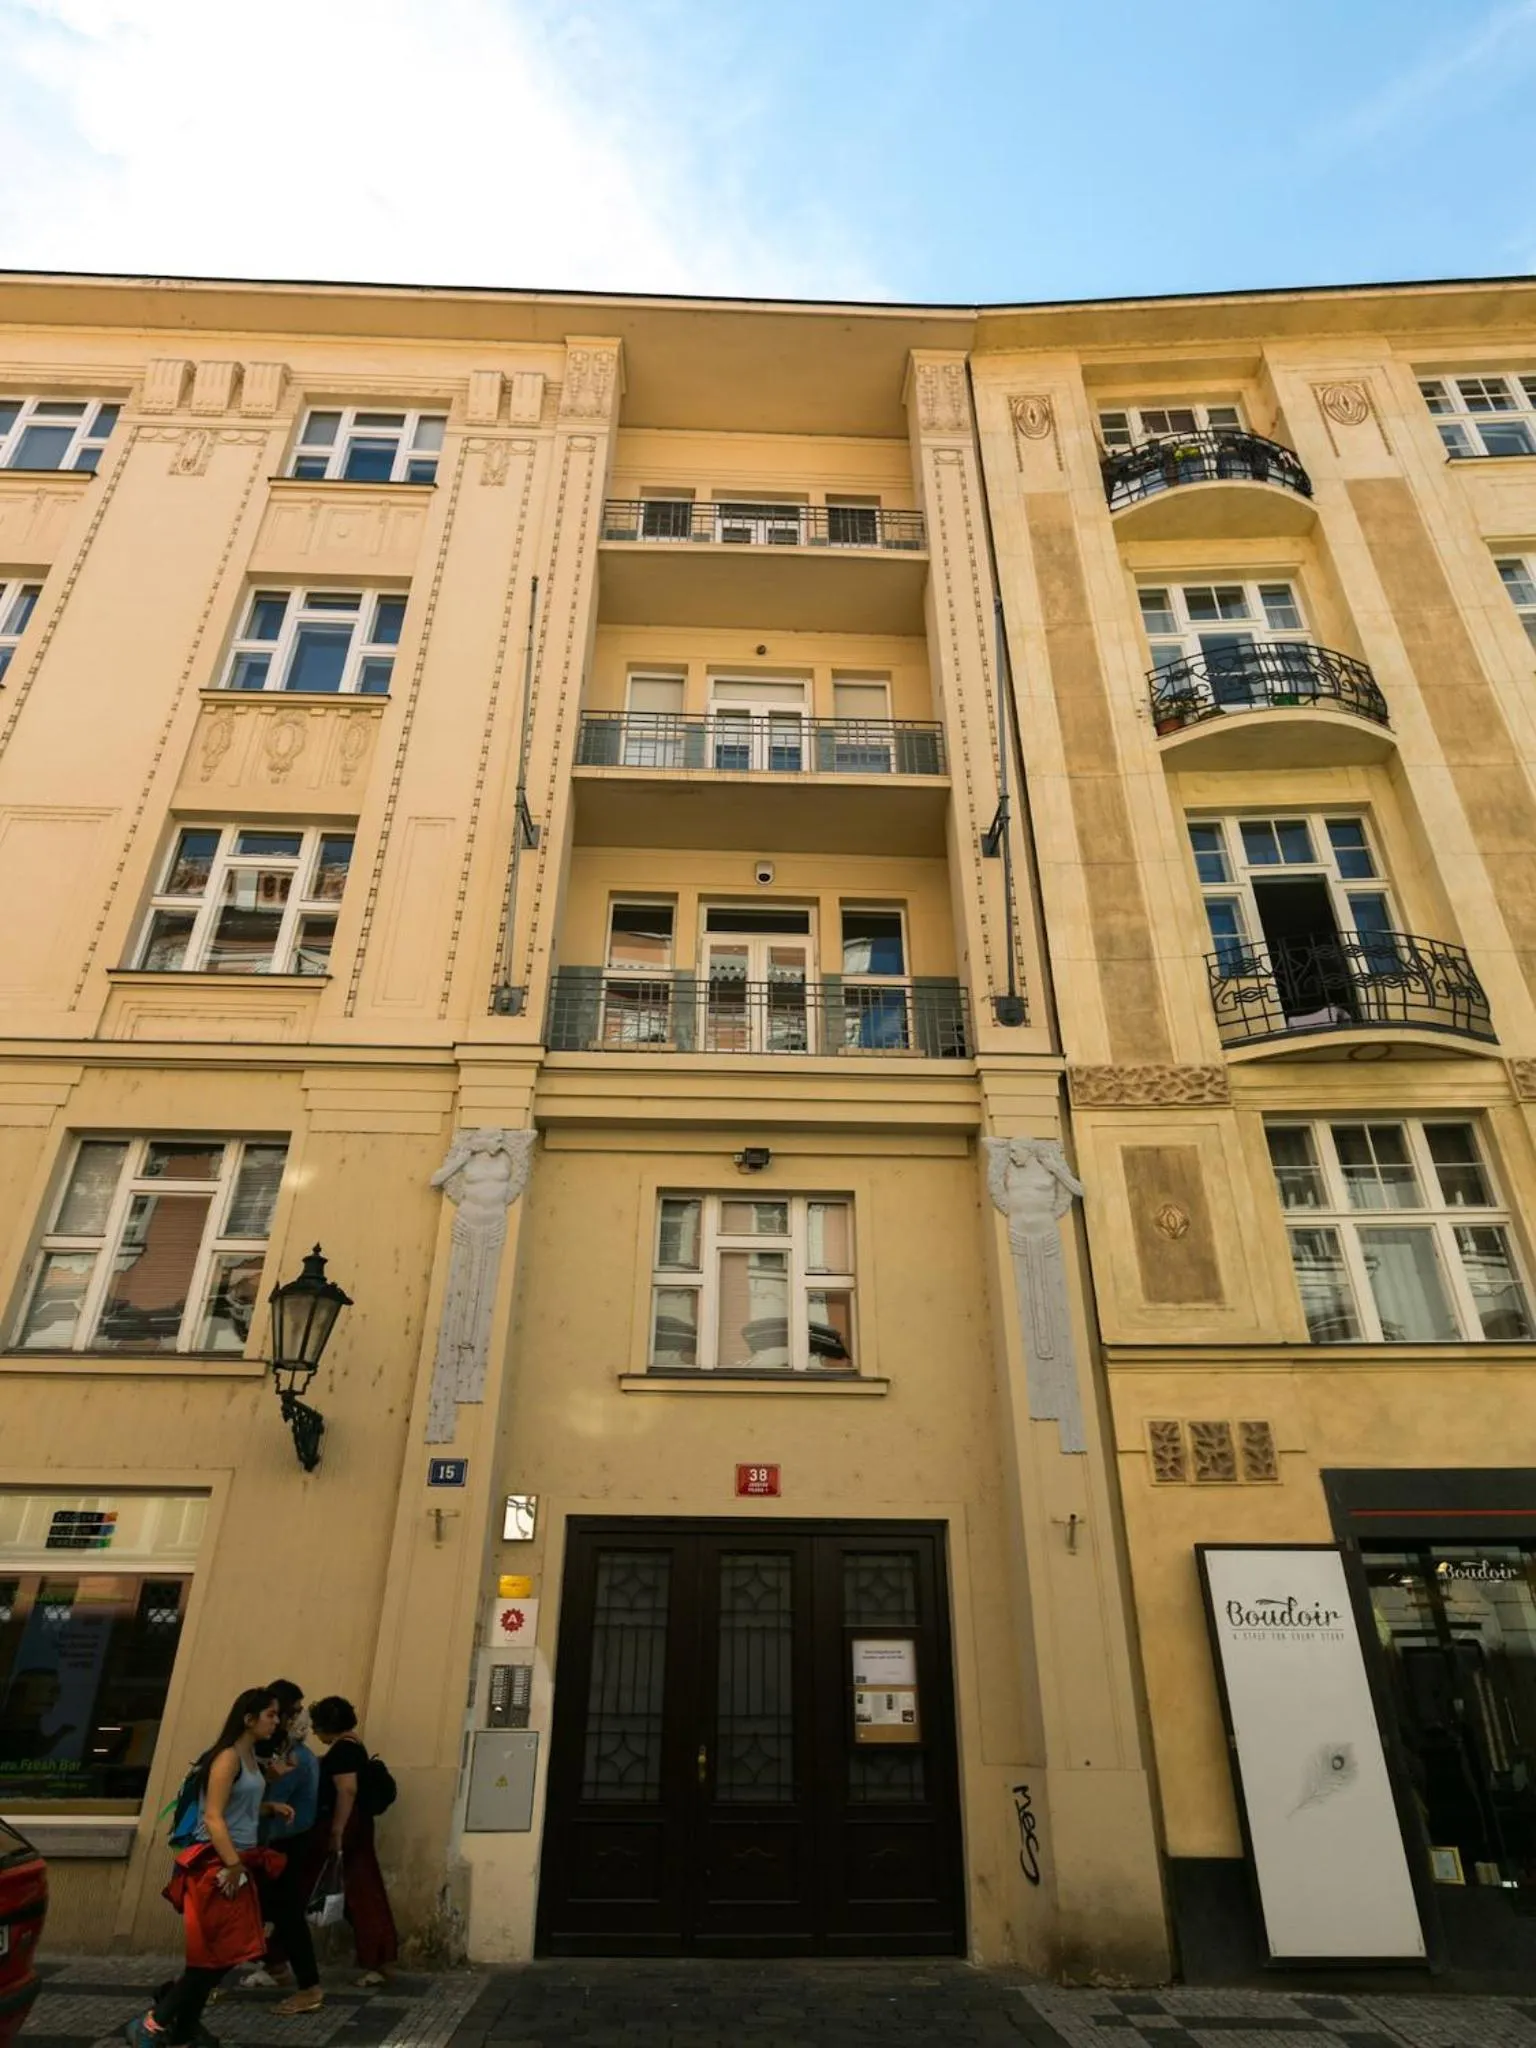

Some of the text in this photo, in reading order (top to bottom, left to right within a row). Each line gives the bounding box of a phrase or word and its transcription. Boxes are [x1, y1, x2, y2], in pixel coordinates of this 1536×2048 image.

[439, 1464, 456, 1480] 15
[750, 1468, 767, 1481] 38
[1437, 1560, 1519, 1580] Boudoir
[1226, 1596, 1343, 1626] Boudoir
